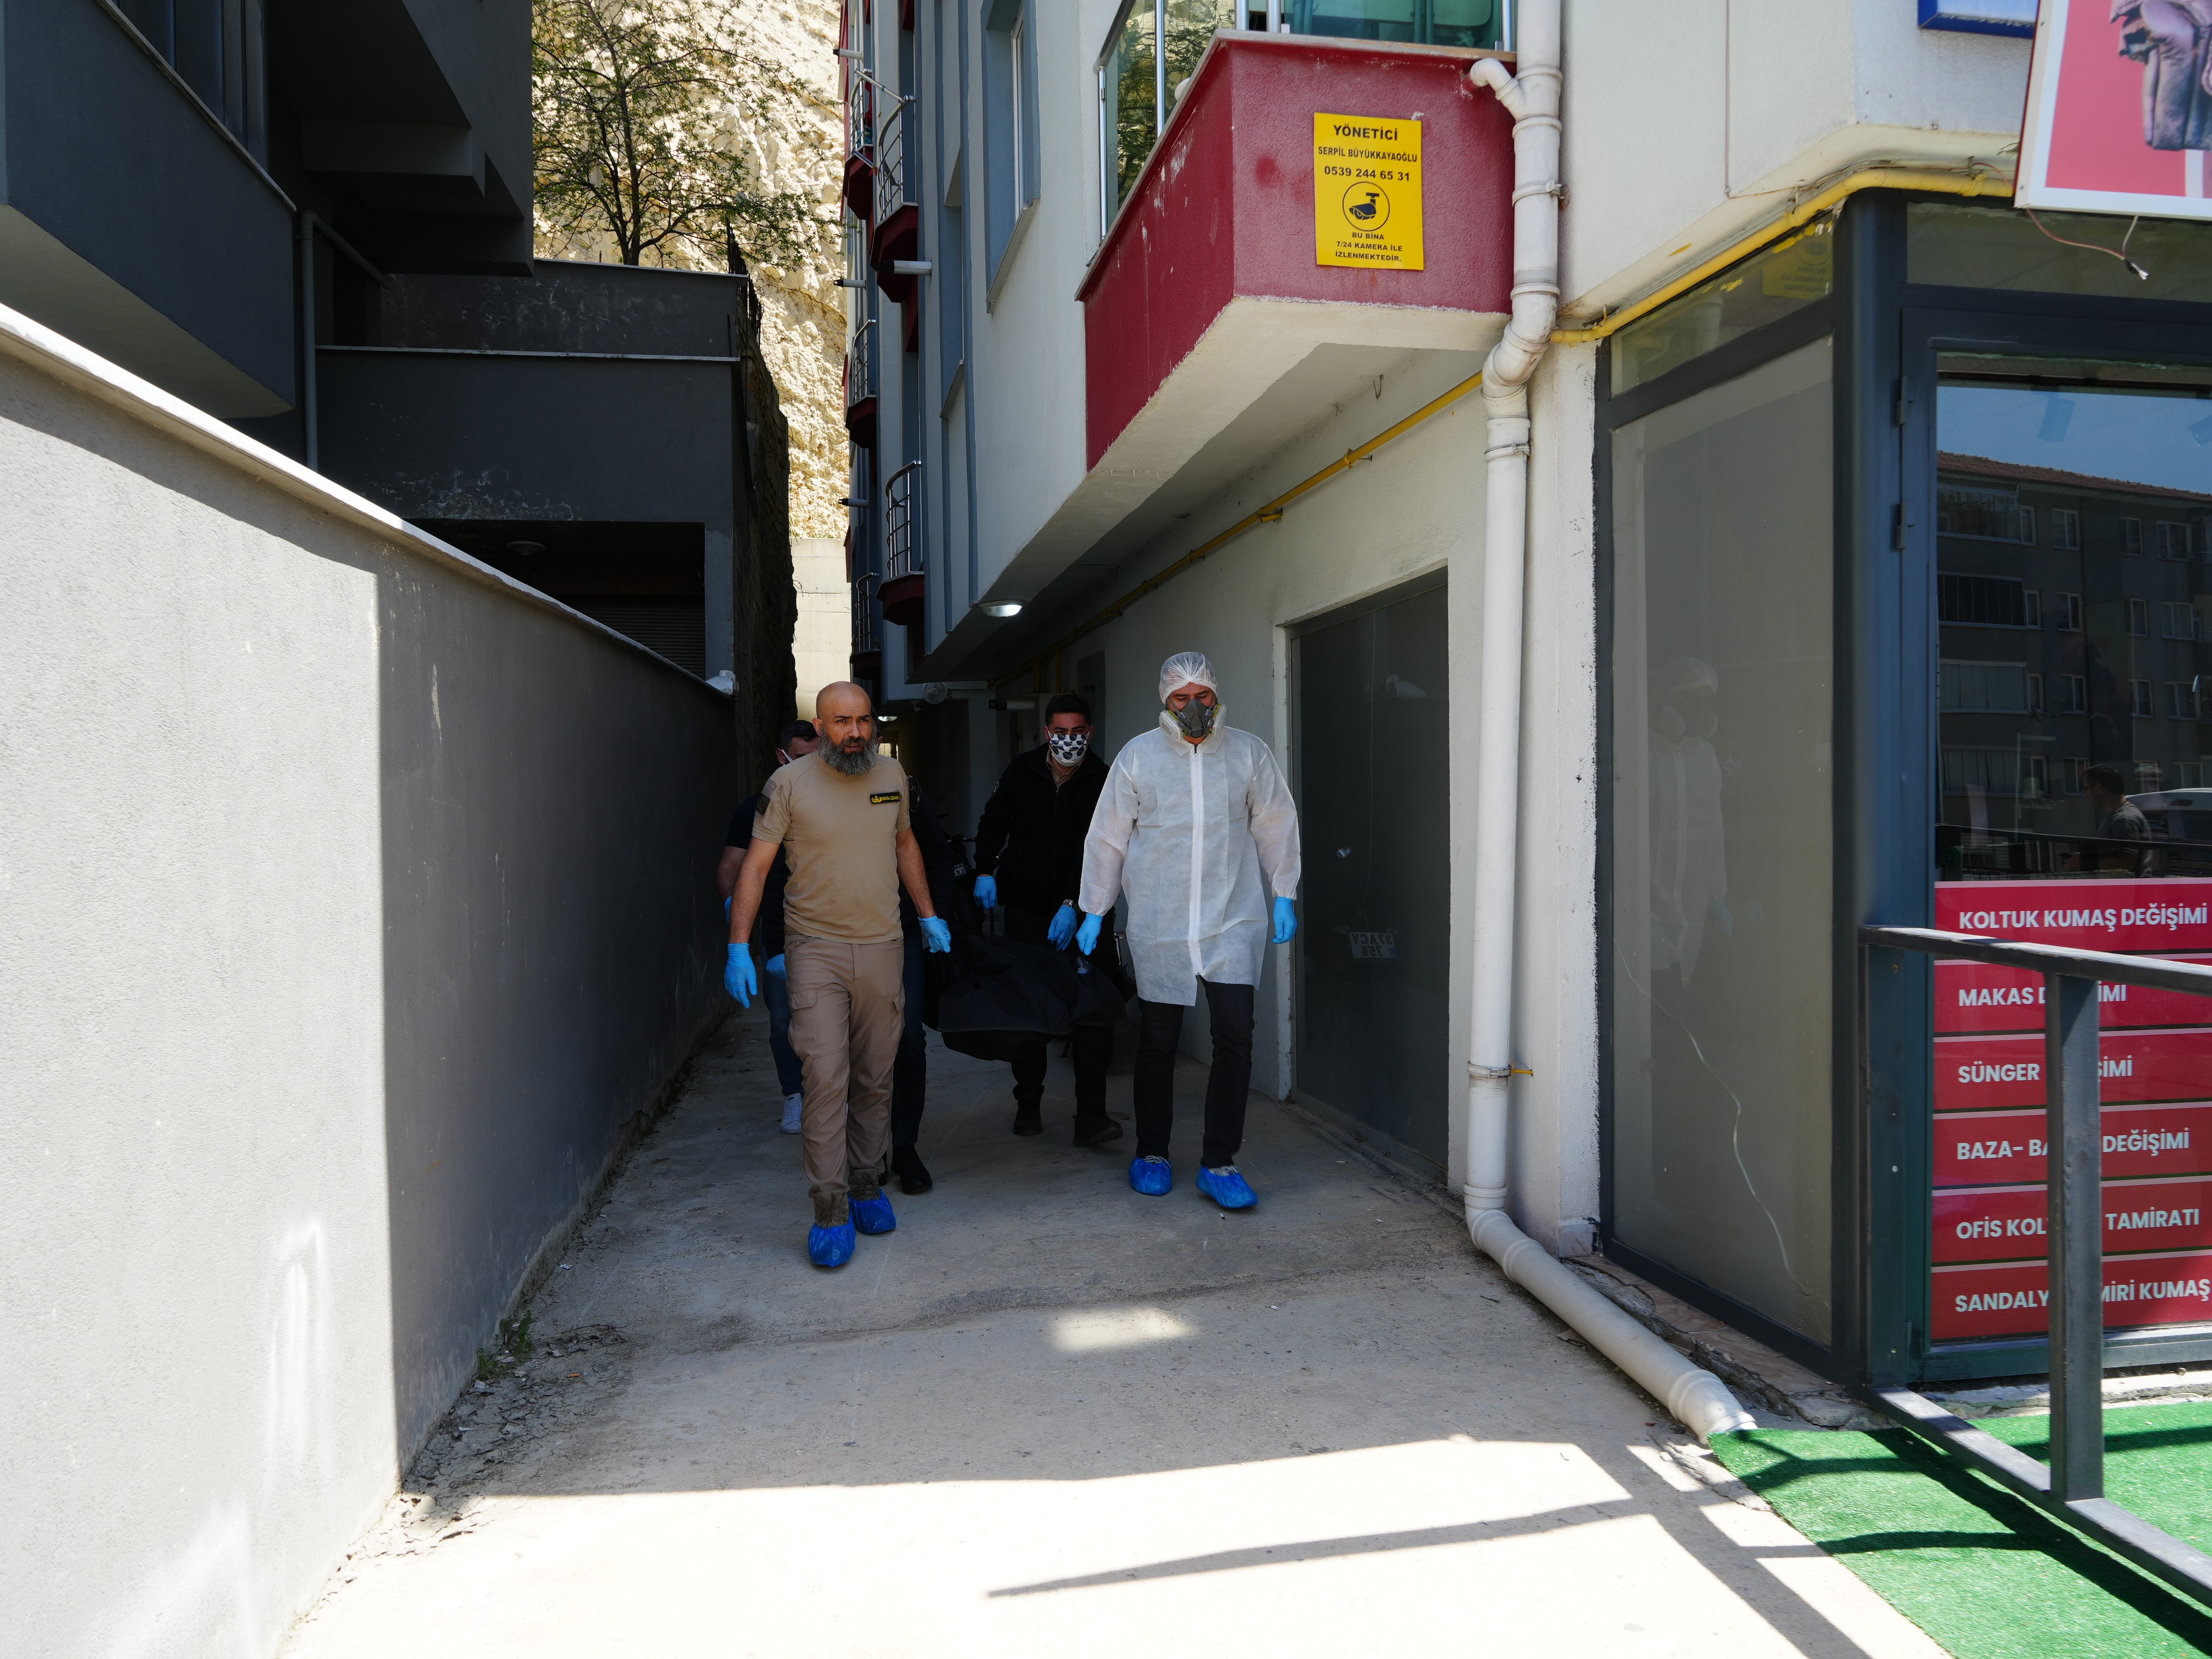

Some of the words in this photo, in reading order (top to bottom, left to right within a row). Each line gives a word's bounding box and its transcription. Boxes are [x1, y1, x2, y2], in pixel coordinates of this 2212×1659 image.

[1333, 123, 1398, 140] YÖNETİCİ
[1318, 146, 1346, 157] SERPİL
[1348, 147, 1417, 162] BÜYÜKKAYAOĞLU
[1324, 166, 1352, 177] 0539
[1355, 168, 1376, 178] 244
[1380, 170, 1393, 180] 65
[1397, 172, 1410, 181] 31
[1365, 232, 1384, 240] BİNA
[1335, 249, 1401, 261] İZLENMEKTEDİR.
[1354, 242, 1388, 251] KAMERA
[1390, 243, 1403, 251] İLE
[1959, 910, 2039, 929] KOLTUK
[2044, 908, 2116, 932] KUMAŞ
[2121, 902, 2207, 931] DEĞİŞİMİ
[1959, 987, 2034, 1006] MAKAS
[1958, 1060, 2040, 1083] SÜNGER
[2102, 1127, 2189, 1156] DEĞİŞİMİ
[1956, 1216, 2002, 1239] OFİS
[2106, 1206, 2199, 1230] TAMİRATI
[2139, 1278, 2210, 1302] KUMAŞ
